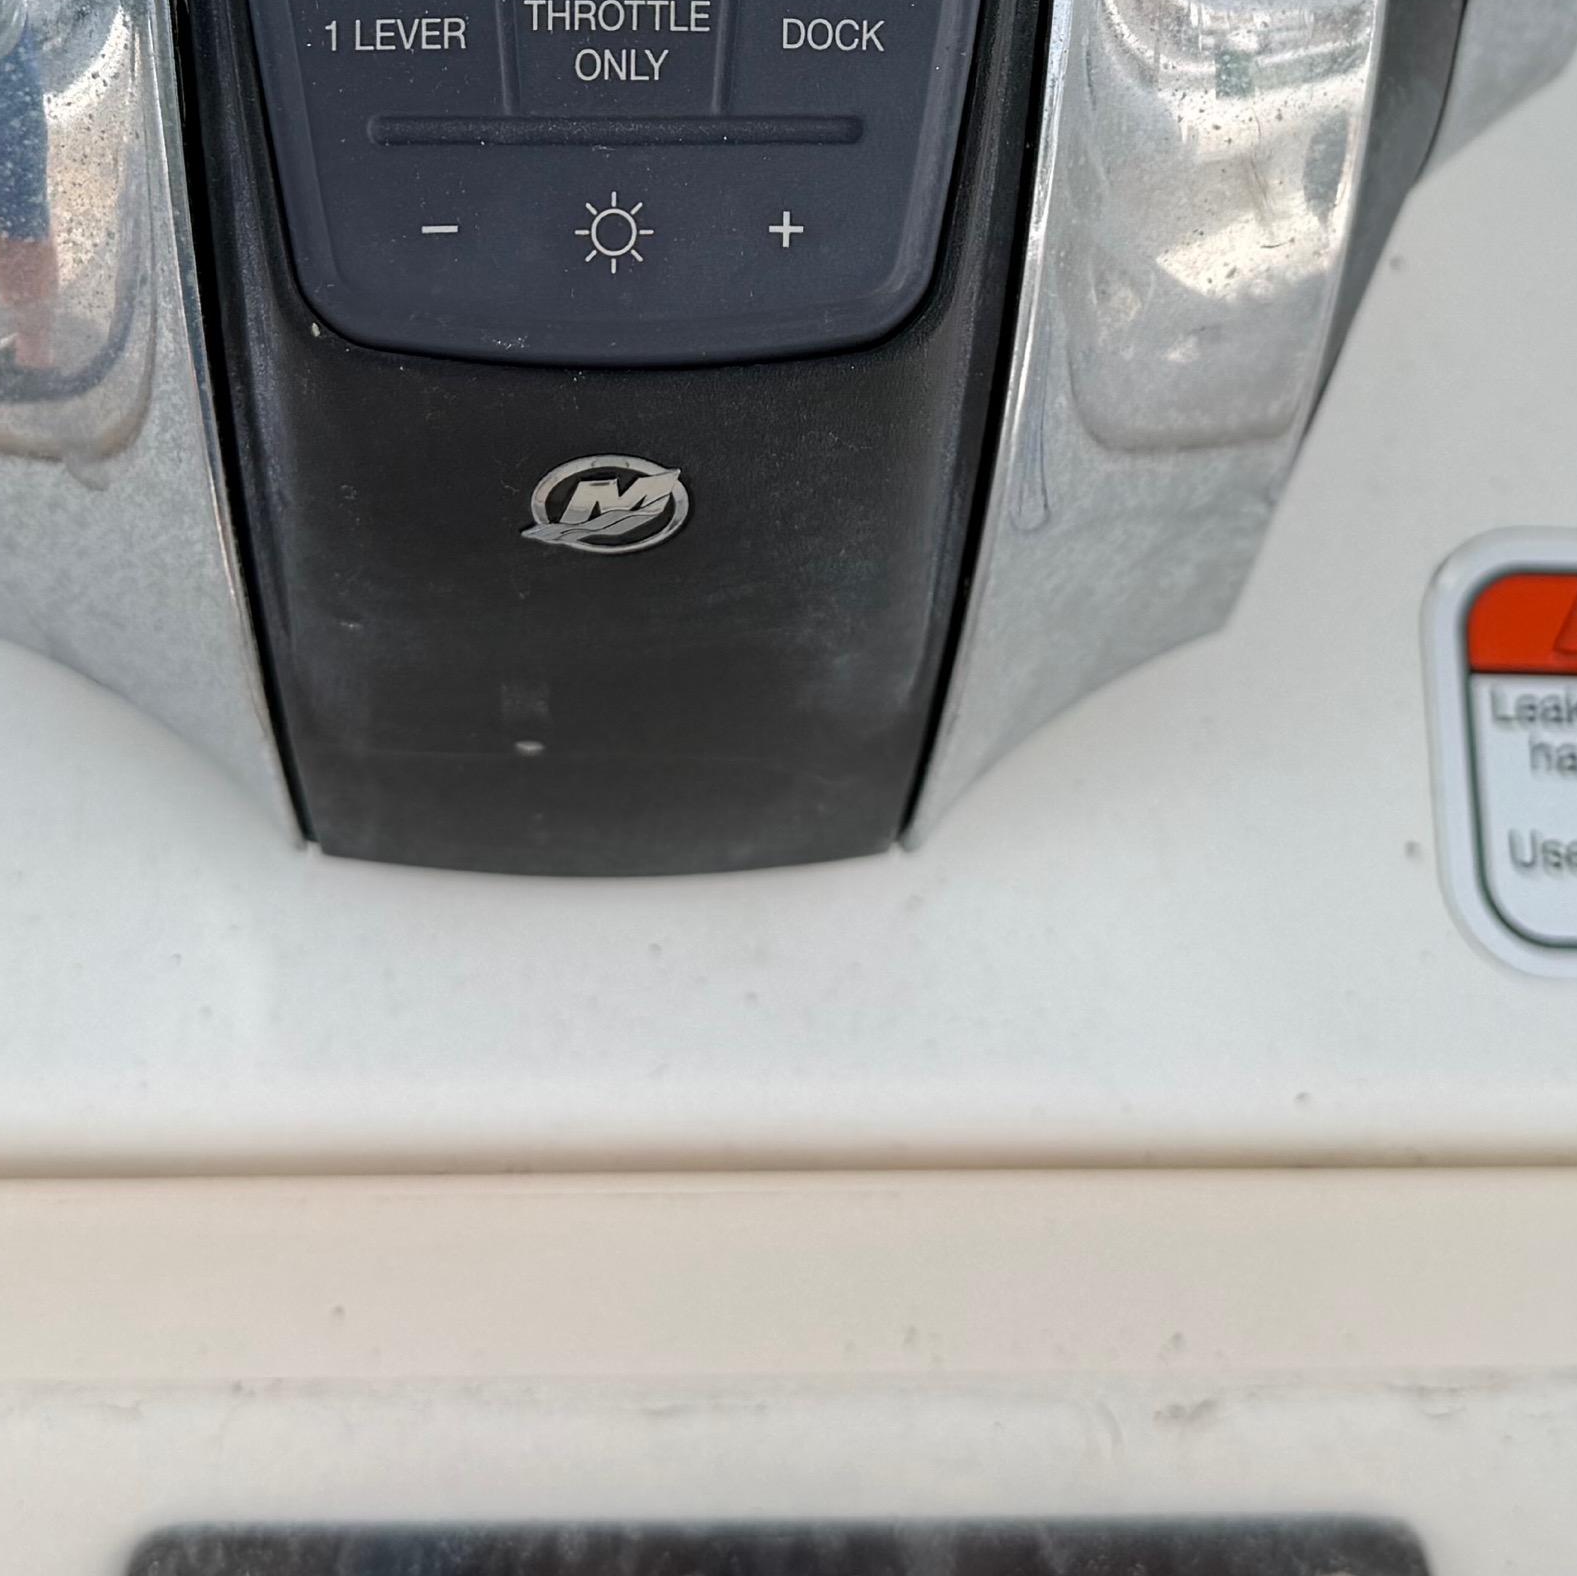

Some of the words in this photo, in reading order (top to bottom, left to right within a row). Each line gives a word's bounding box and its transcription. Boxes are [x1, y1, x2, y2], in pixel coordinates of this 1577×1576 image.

[324, 20, 340, 52] 1
[354, 17, 468, 52] LEVER
[781, 18, 886, 53] DOCK
[574, 48, 670, 82] ONLY
